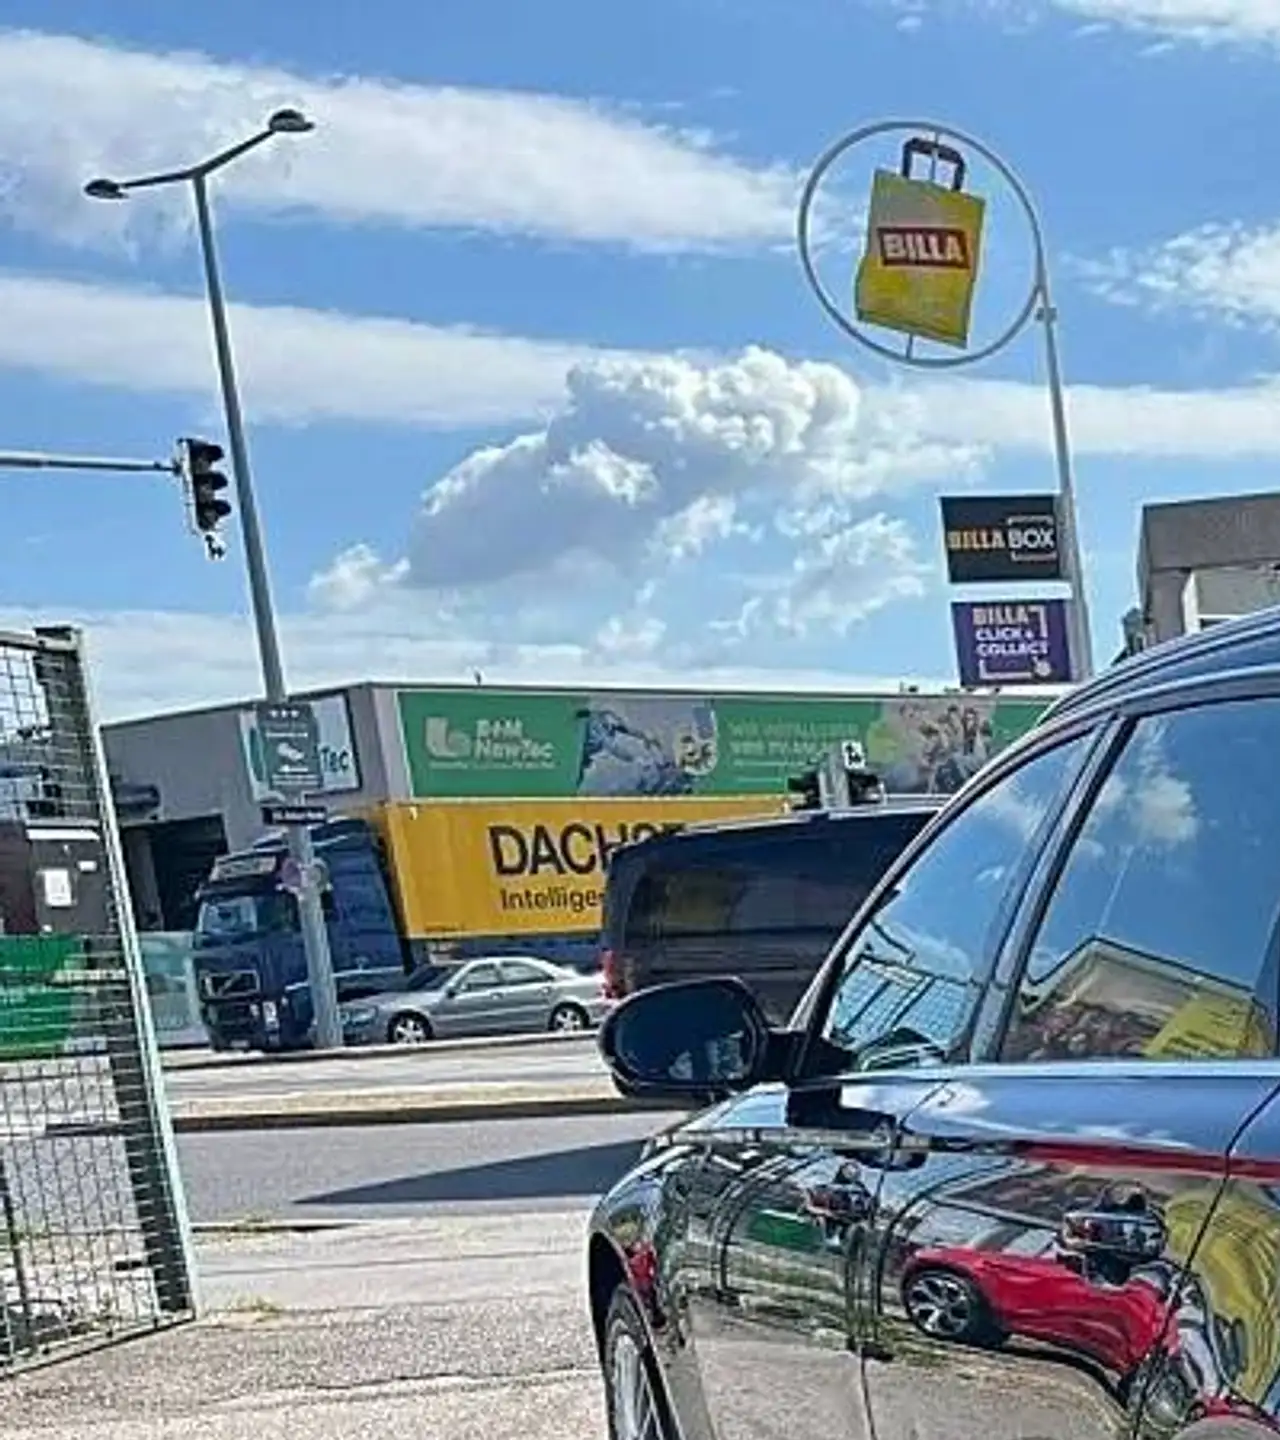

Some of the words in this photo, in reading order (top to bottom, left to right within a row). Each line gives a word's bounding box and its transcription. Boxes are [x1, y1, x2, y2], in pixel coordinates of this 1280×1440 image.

[882, 232, 965, 262] BILLA
[948, 529, 1005, 549] BILLA
[1008, 529, 1055, 549] BOX
[973, 605, 1030, 625] BILLA
[976, 627, 1026, 641] CLICK
[317, 746, 349, 773] Tec
[489, 822, 685, 876] DACH
